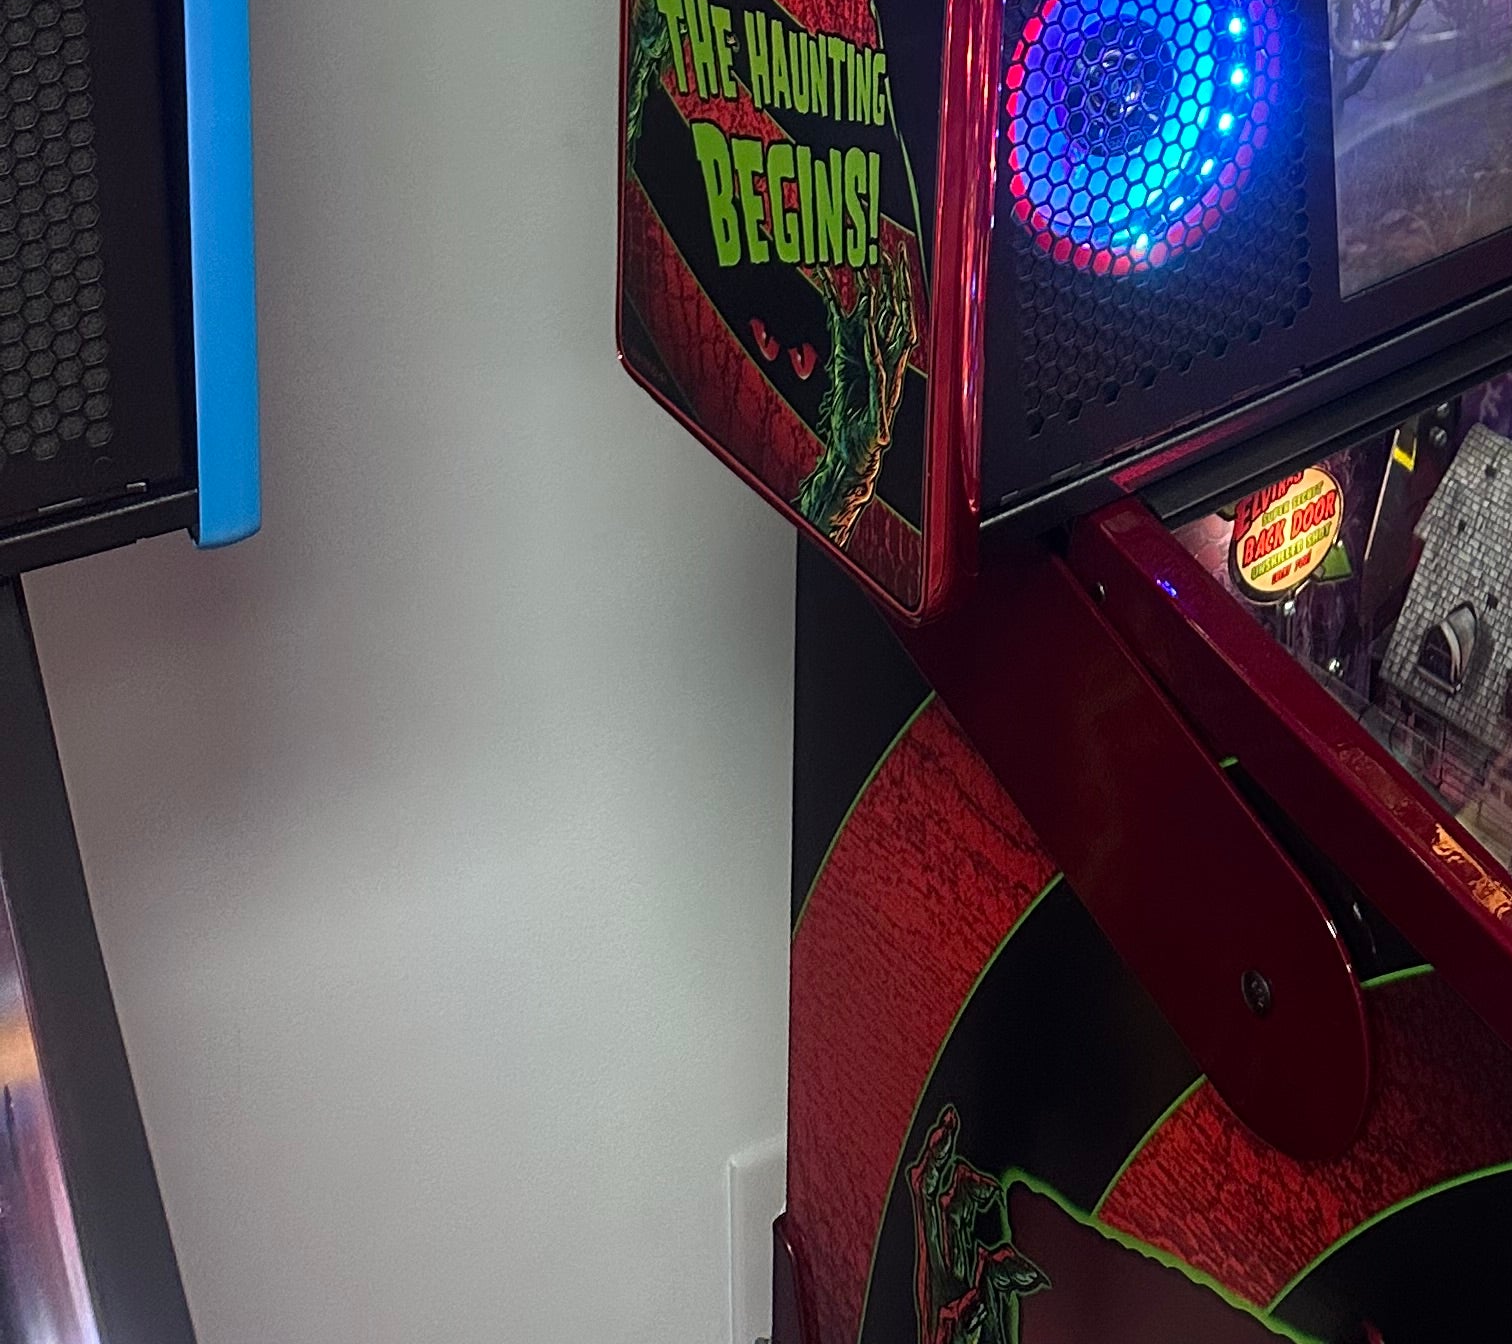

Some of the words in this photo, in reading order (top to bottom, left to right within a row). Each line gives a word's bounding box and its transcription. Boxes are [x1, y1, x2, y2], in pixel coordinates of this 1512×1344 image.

[744, 9, 887, 127] HAUNTING
[691, 121, 881, 268] BEGINS!
[1242, 517, 1287, 568] BACK
[1290, 489, 1338, 540] DOOR
